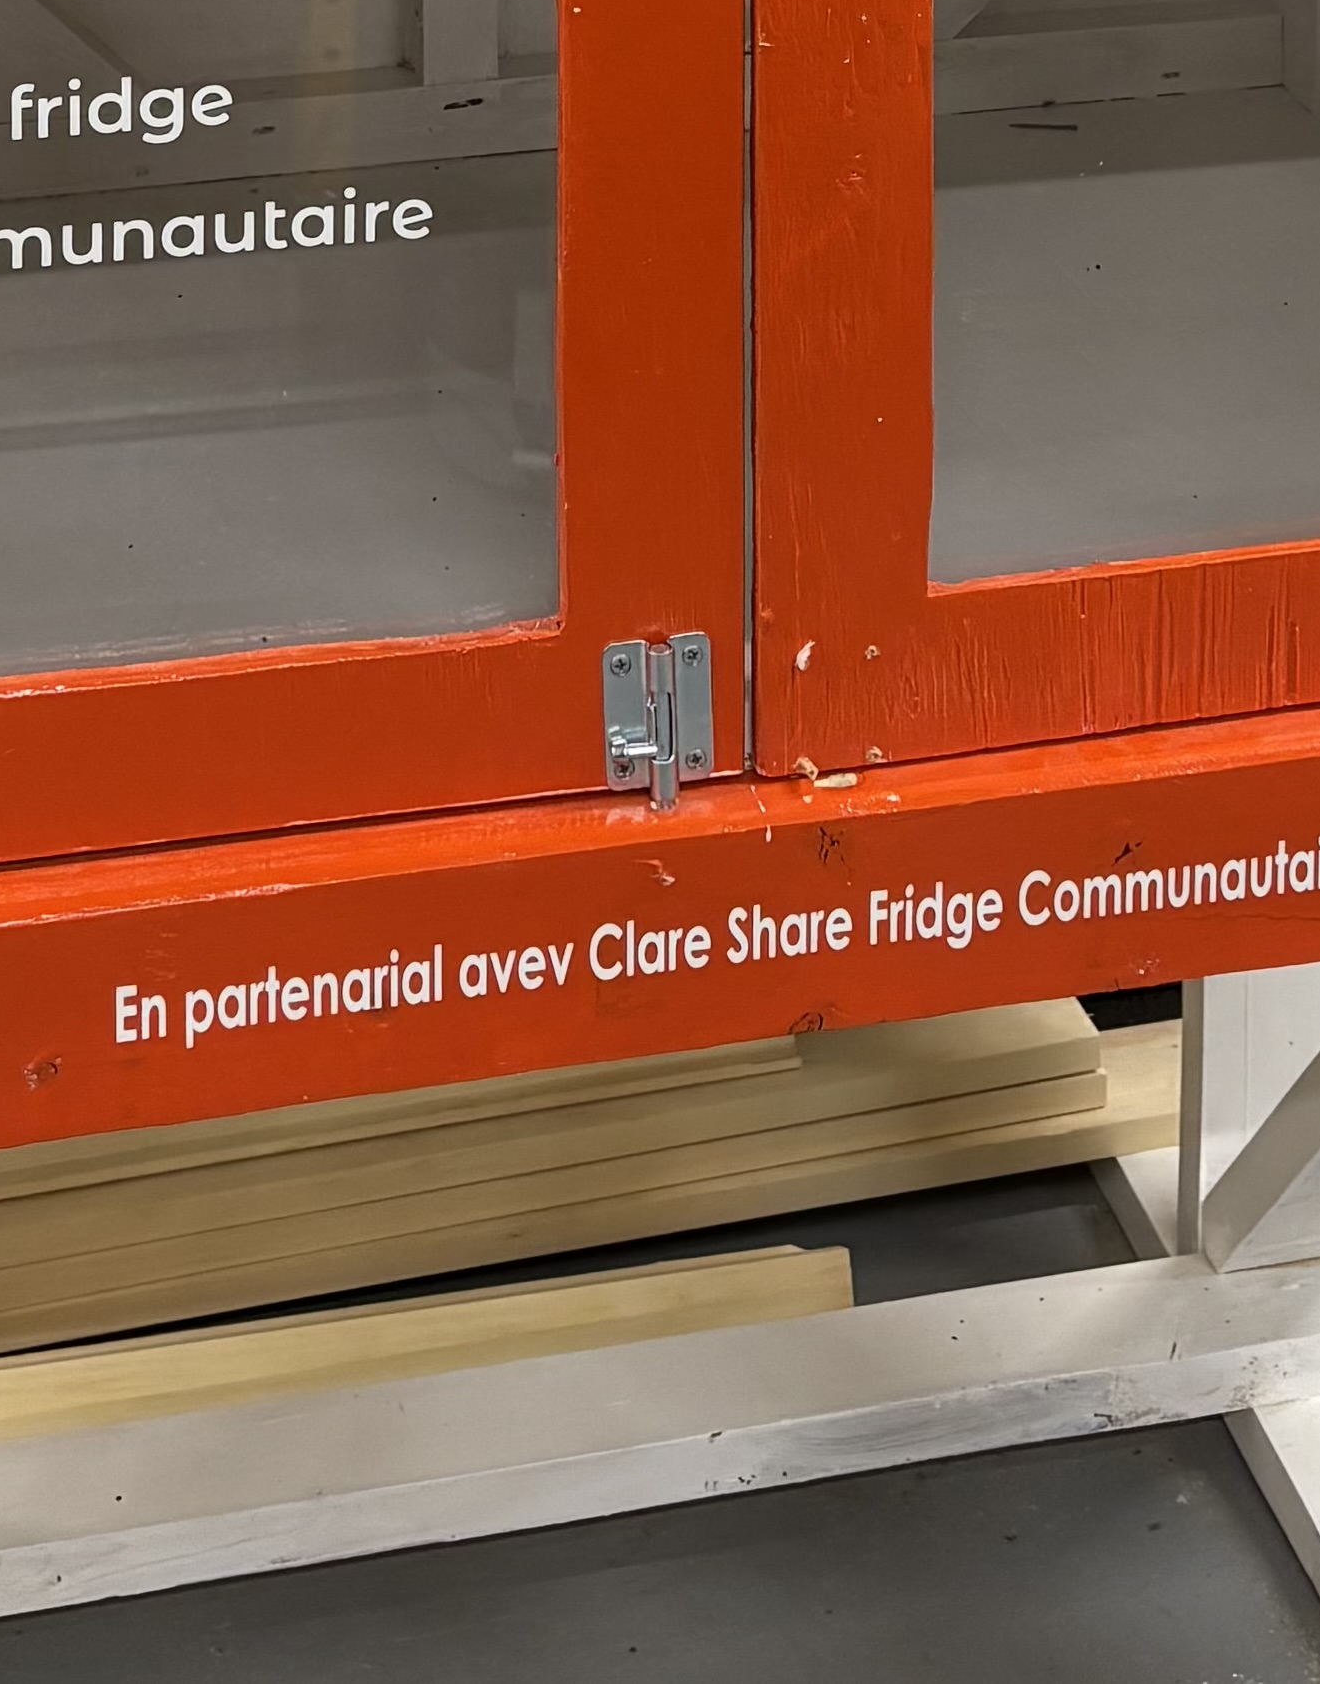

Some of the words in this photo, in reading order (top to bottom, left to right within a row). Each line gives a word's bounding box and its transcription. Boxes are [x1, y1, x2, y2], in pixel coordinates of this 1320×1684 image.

[10, 76, 234, 145] fridge
[115, 985, 168, 1043] En
[185, 944, 444, 1049] partenarial
[459, 943, 575, 998] avev
[589, 920, 712, 981] Clare
[726, 904, 853, 964] Share
[869, 881, 1004, 949] Fridge
